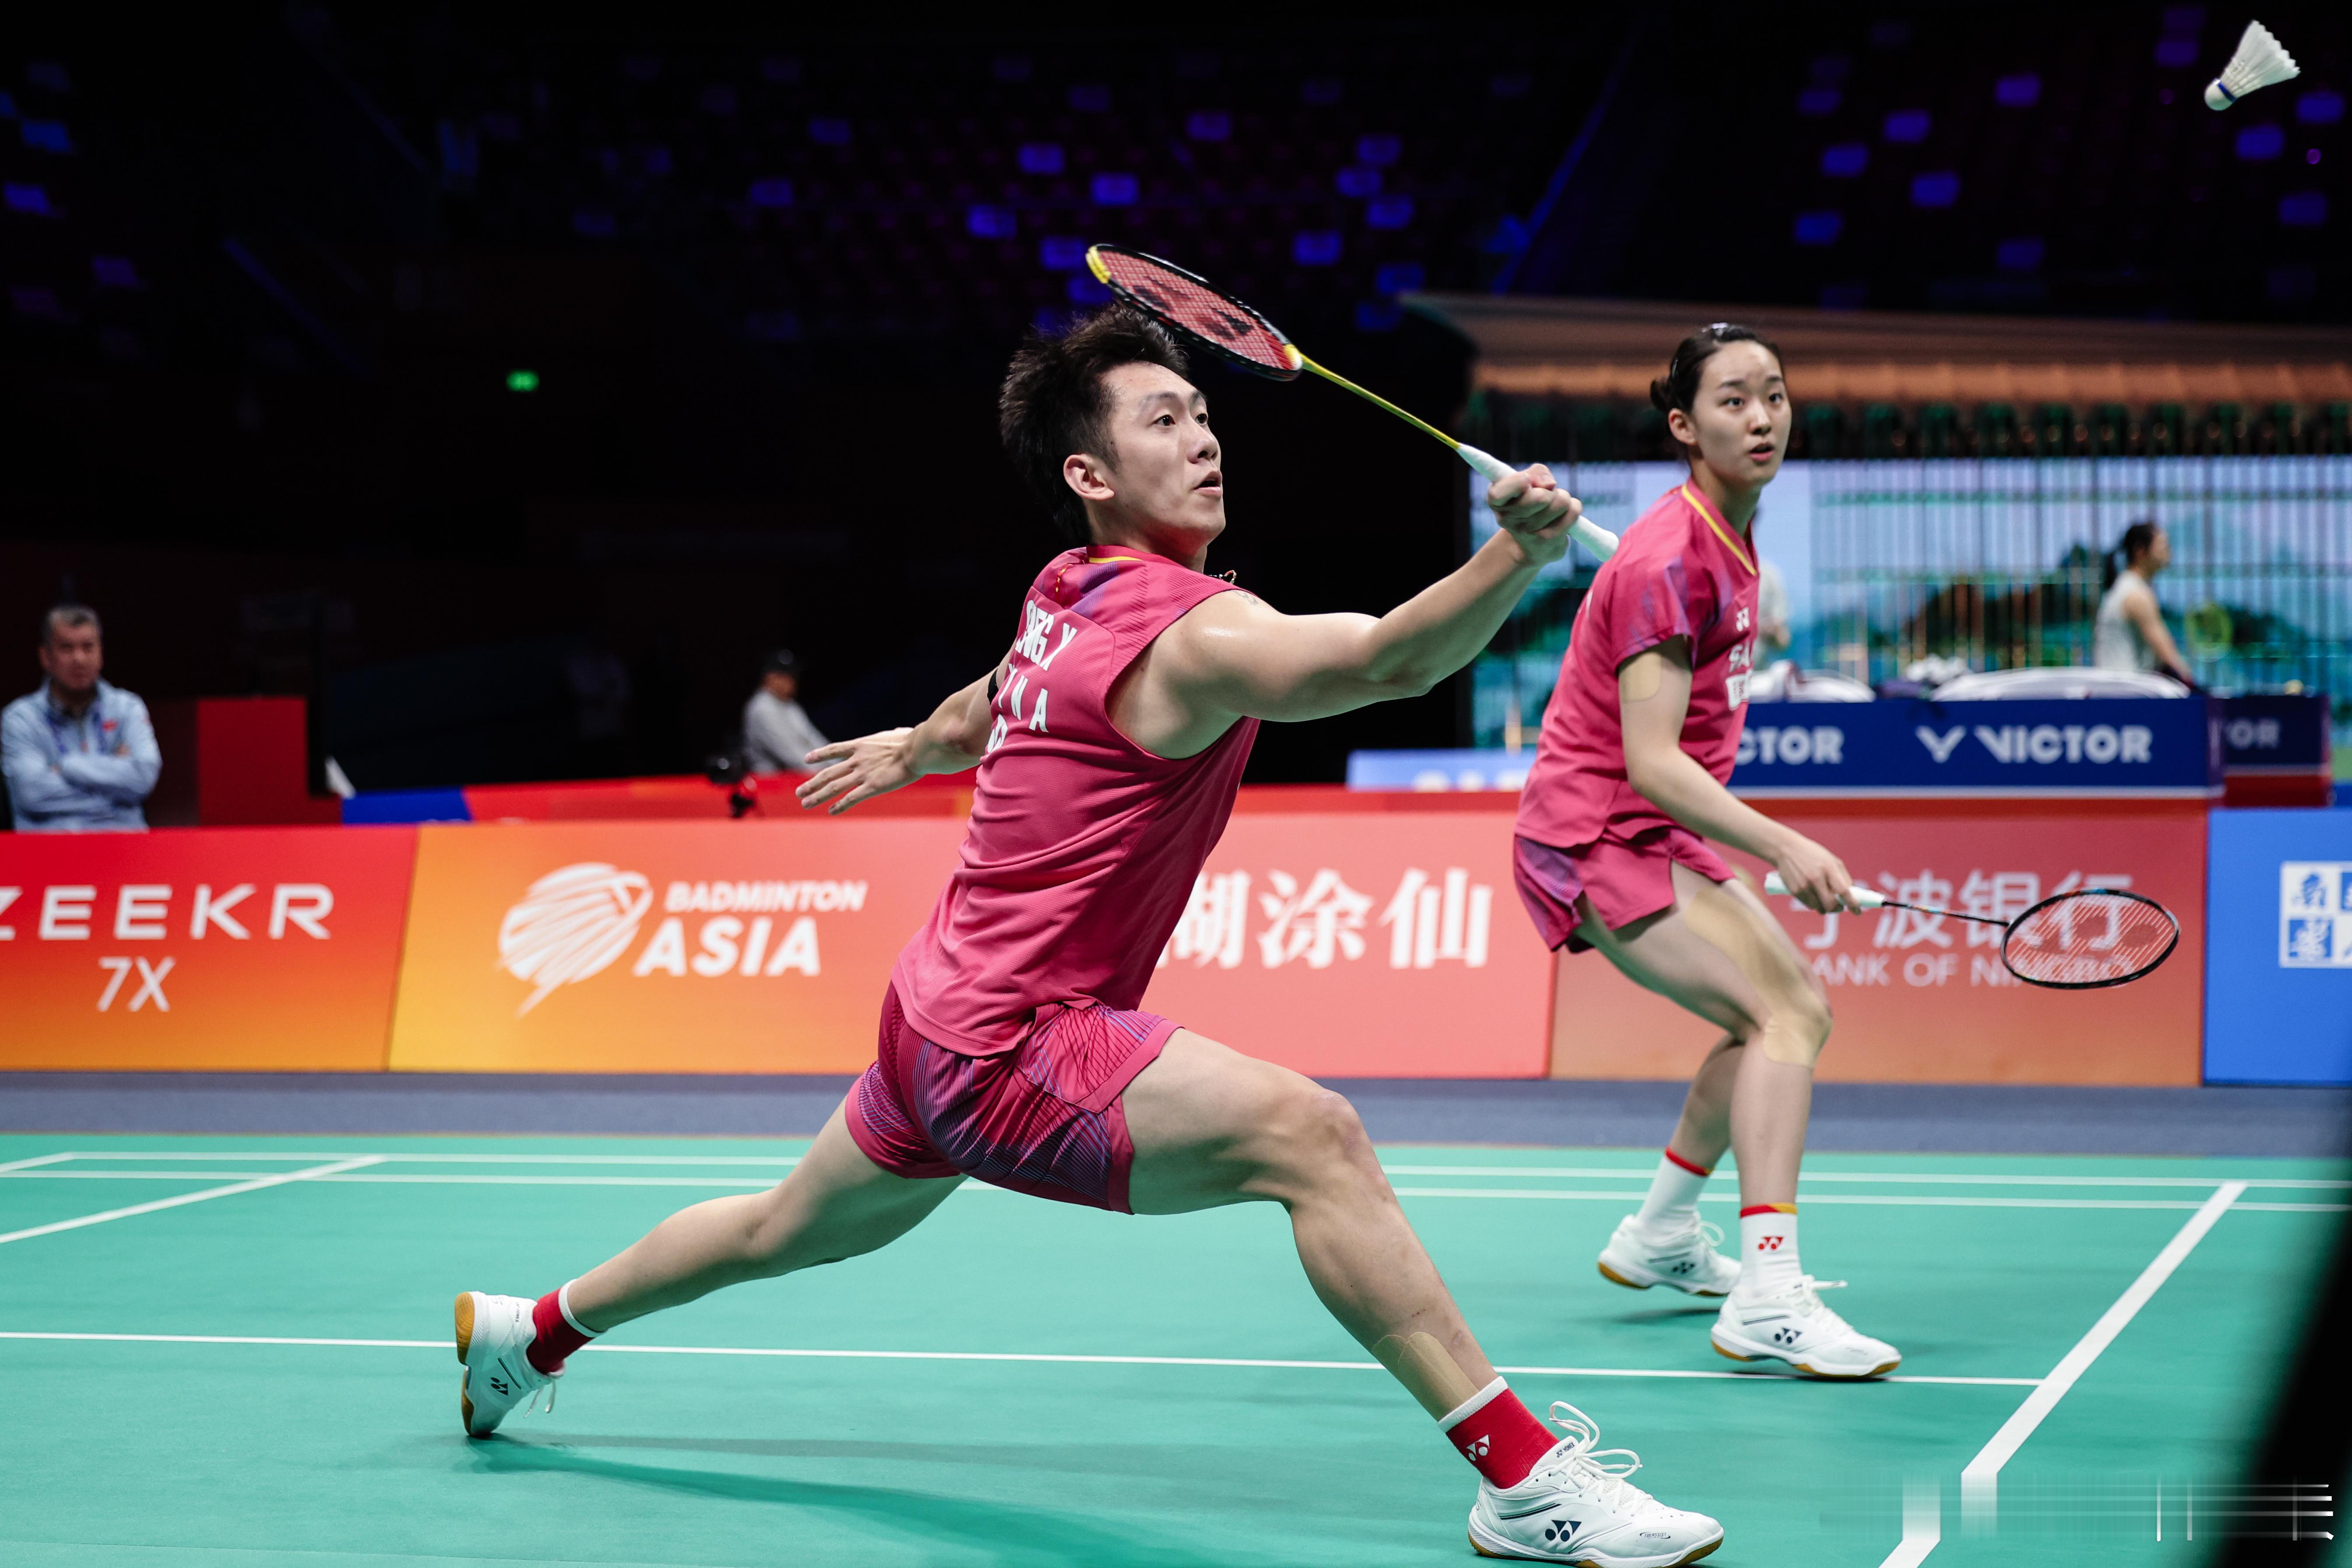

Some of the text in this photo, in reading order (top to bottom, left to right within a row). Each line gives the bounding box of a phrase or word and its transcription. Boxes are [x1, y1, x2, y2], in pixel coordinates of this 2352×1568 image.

[1734, 725, 1845, 766] CTOR
[1973, 724, 2152, 764] VICTOR
[664, 880, 868, 912] BADMINTON
[633, 915, 821, 977] ASIA
[97, 956, 176, 1012] 7X
[1812, 953, 1891, 987] ANK
[1903, 952, 1960, 987] OF
